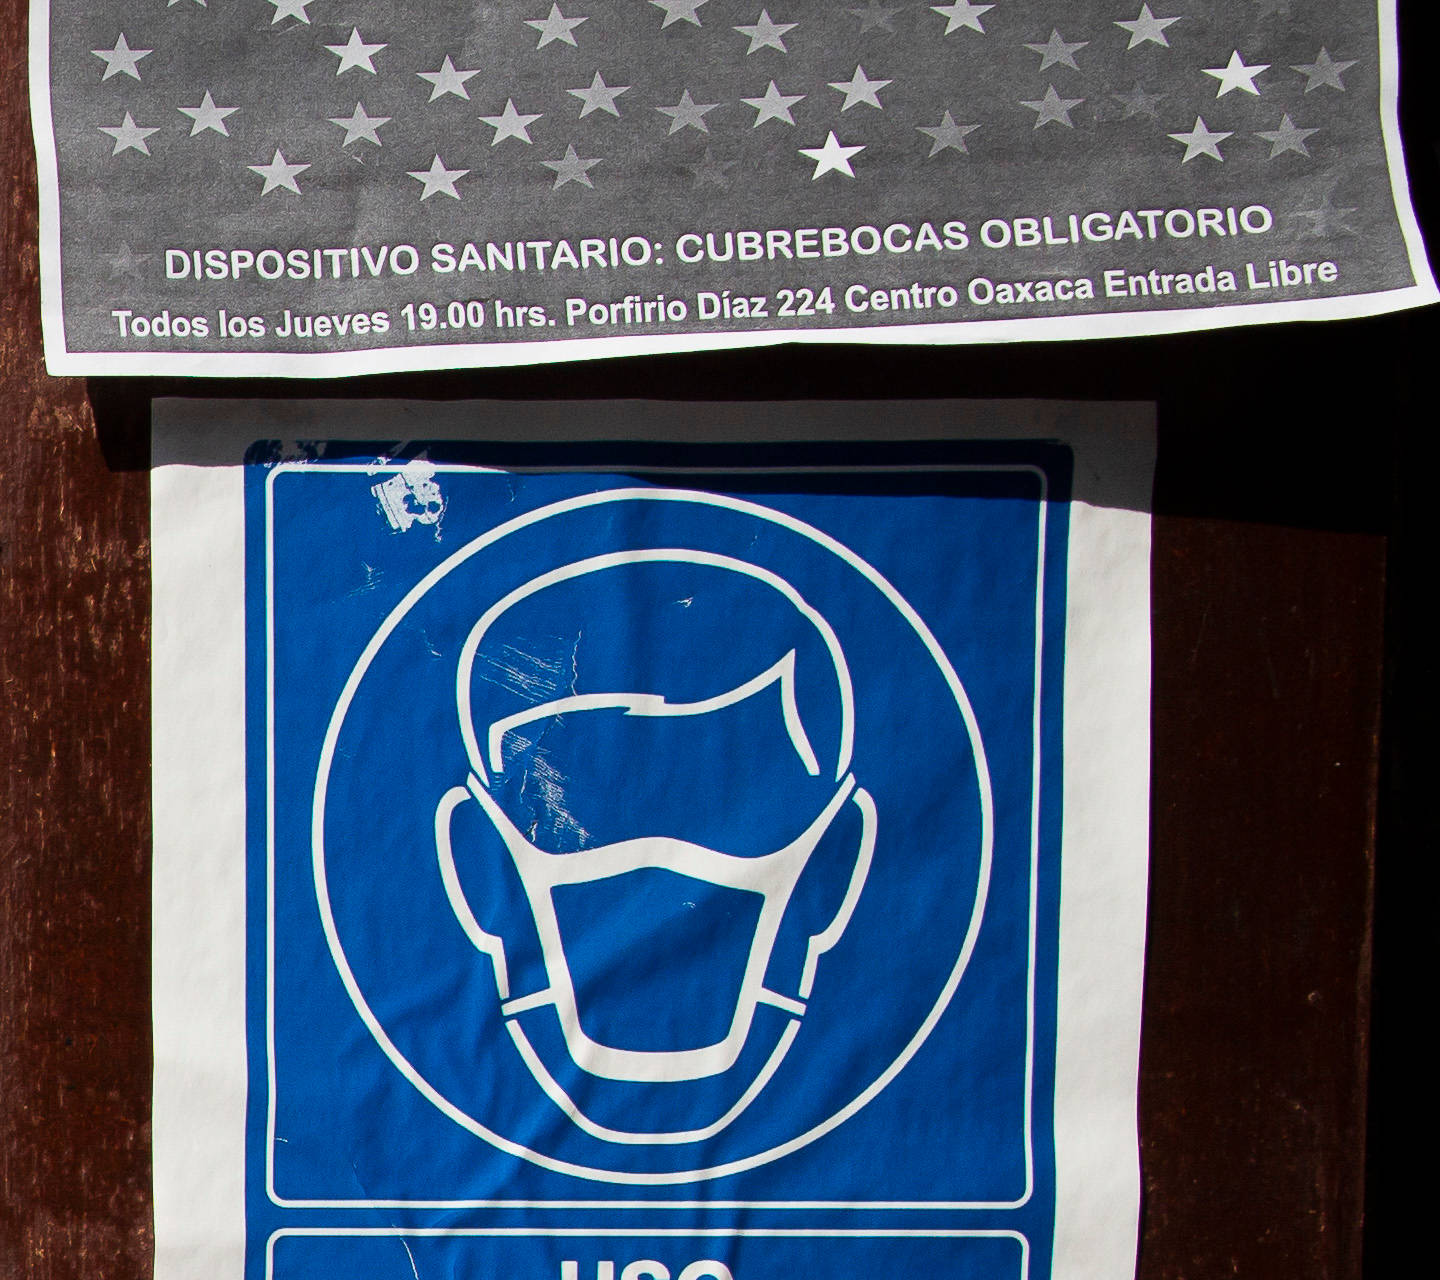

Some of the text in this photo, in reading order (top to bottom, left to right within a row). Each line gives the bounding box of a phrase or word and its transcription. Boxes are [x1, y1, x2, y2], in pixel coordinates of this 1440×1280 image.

[166, 204, 1273, 281] DISPOSITIVO SANITARIO: CUBREBOCAS OBLIGATORIO
[111, 259, 1339, 339] Todos los Jueves 19.00 hrs. Porfirio Díaz 224 Centro Oaxaca Entrada Libre
